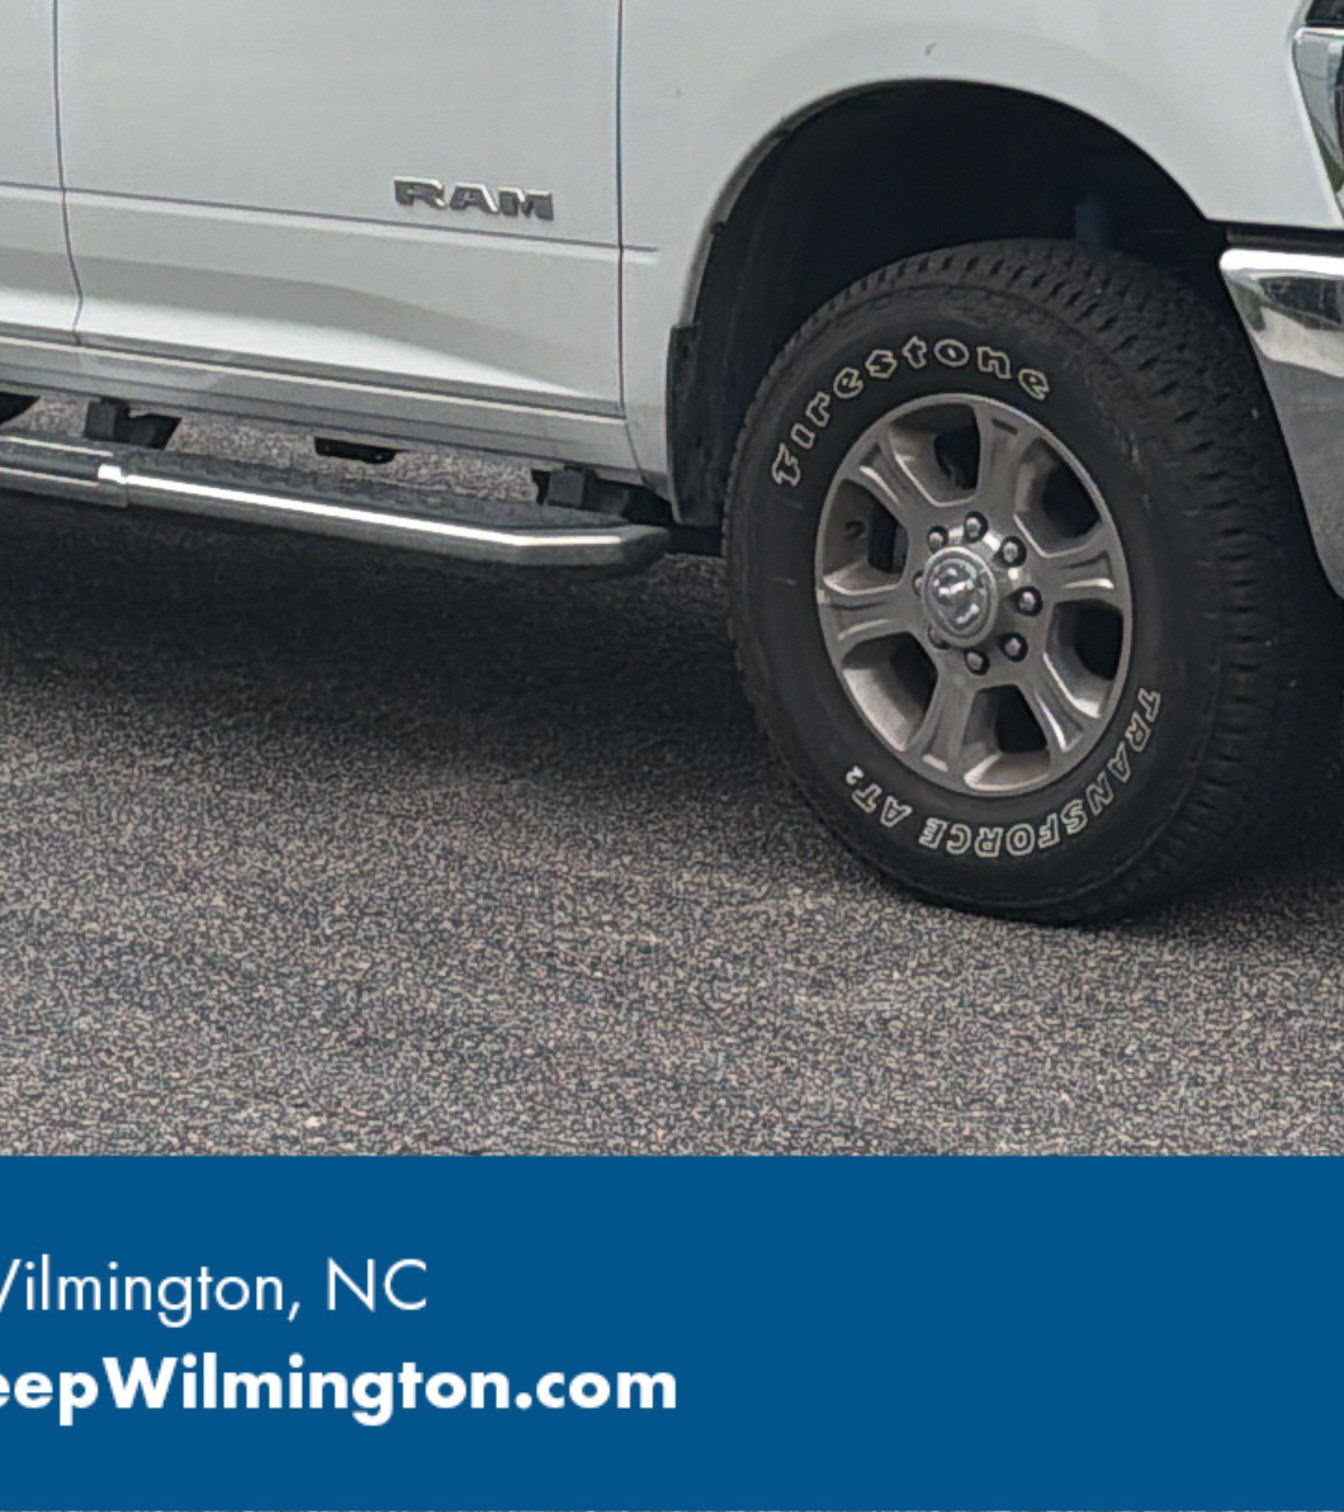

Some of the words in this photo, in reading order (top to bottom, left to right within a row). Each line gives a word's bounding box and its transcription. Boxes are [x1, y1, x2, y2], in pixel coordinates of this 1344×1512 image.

[392, 175, 555, 221] RAM
[771, 336, 1049, 487] Firestone
[918, 687, 1162, 858] TRANSFORCE
